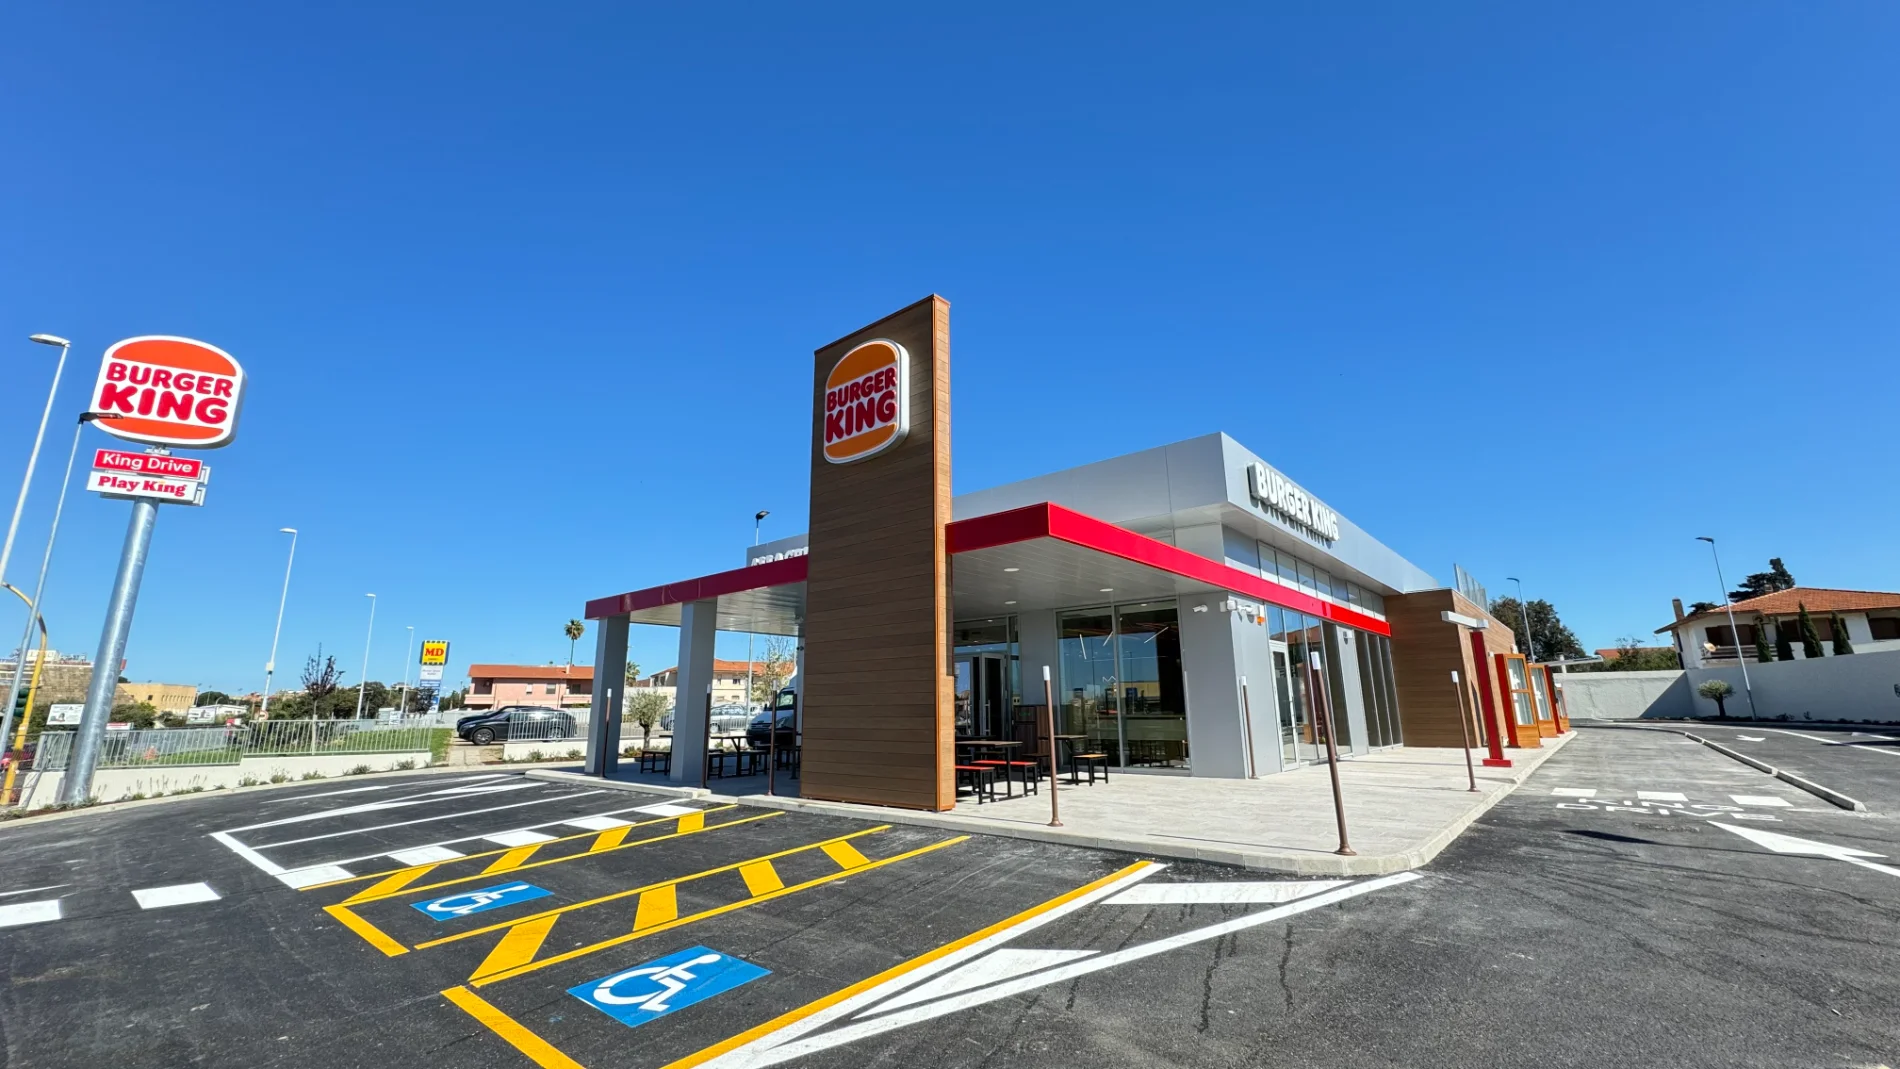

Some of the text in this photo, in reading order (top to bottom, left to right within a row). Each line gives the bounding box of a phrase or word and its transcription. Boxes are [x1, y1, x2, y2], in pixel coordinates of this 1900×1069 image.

[106, 362, 234, 398] BURGER
[826, 367, 897, 412] BURGER
[98, 383, 229, 424] KING
[825, 390, 897, 443] KING
[102, 453, 193, 473] King Drive
[98, 475, 187, 497] Play King
[1254, 461, 1340, 541] BURGER KING
[425, 648, 444, 656] MD
[1556, 803, 1783, 822] DRIVE
[1578, 798, 1744, 812] KING
